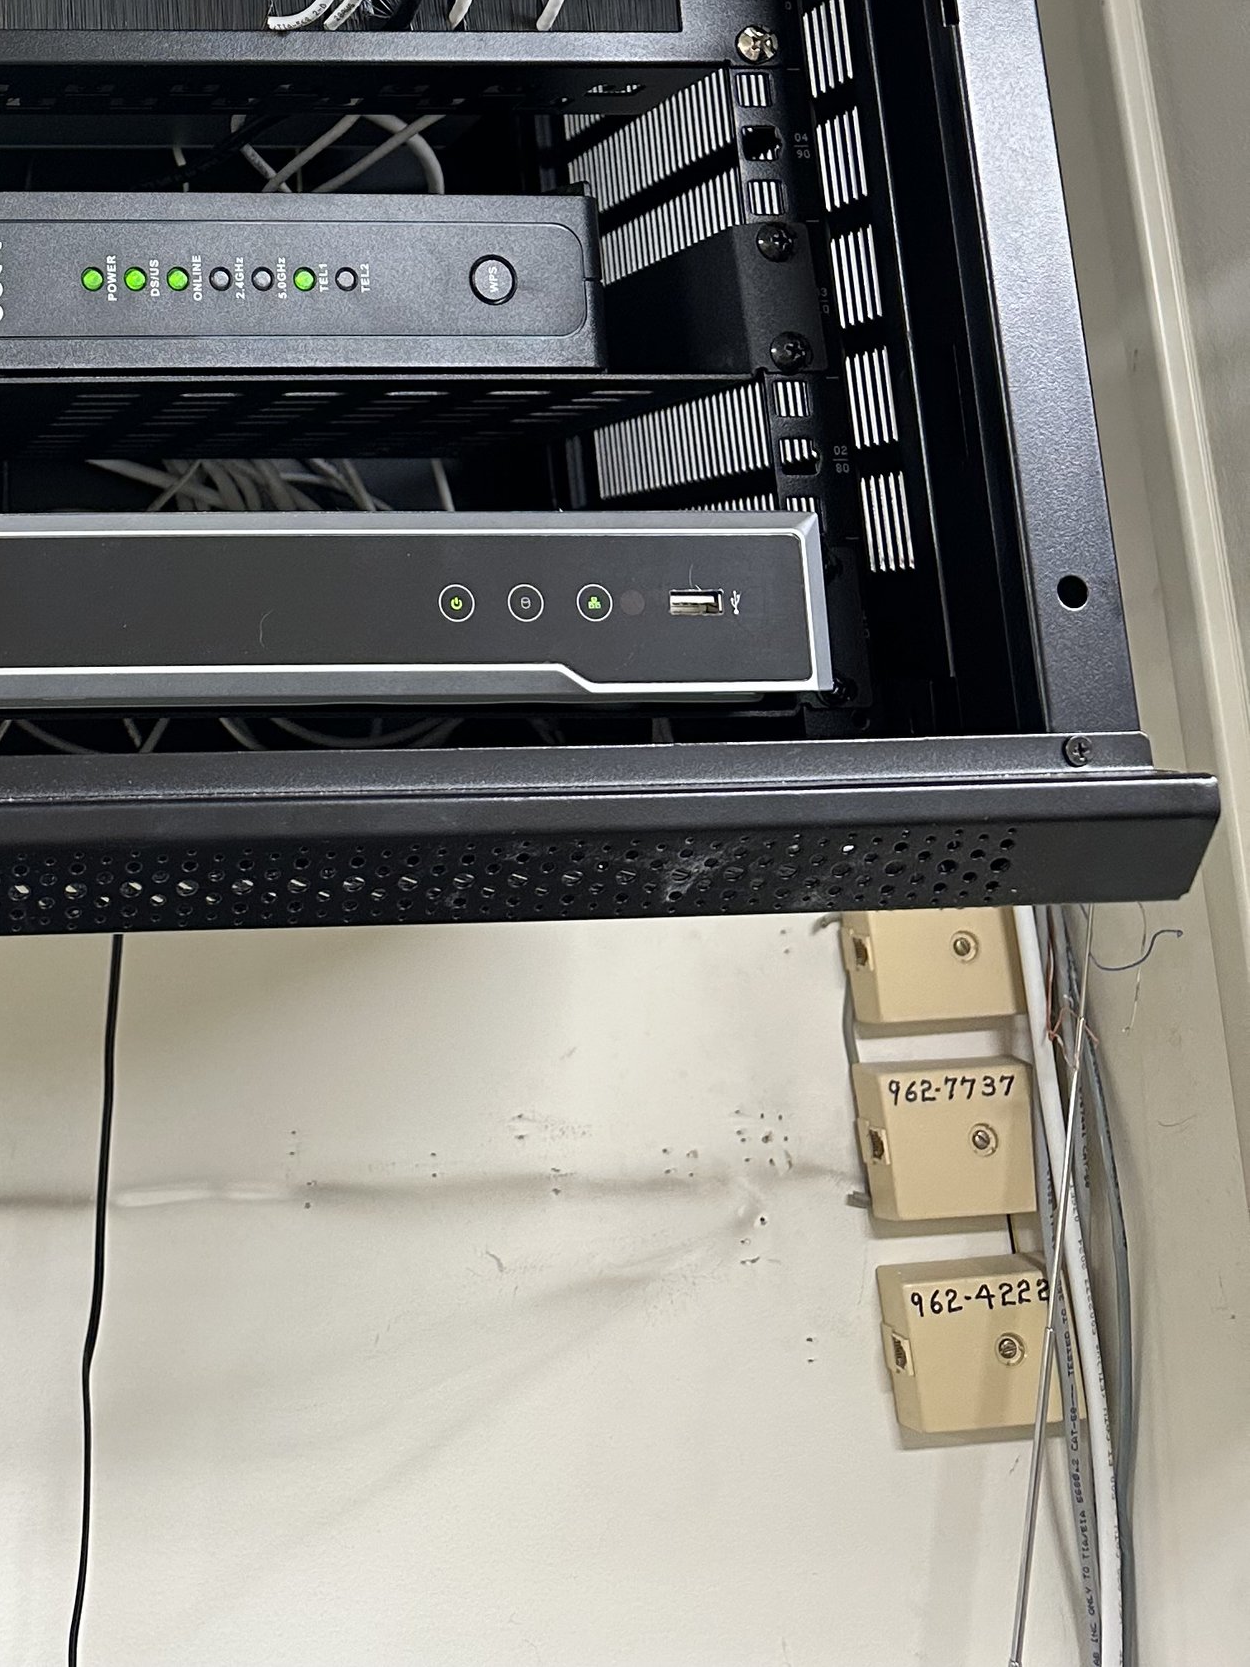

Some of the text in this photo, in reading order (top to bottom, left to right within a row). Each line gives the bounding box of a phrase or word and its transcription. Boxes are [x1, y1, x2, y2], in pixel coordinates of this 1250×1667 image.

[794, 132, 809, 143] 04
[106, 255, 118, 302] POWER
[150, 259, 160, 297] DS/US
[192, 255, 202, 301] ONLINE
[236, 257, 245, 300] 2.4GHz
[278, 257, 288, 300] 5.0GHz
[319, 263, 329, 293] TEL1
[360, 263, 370, 293] TEL2
[488, 266, 499, 293] WPS
[833, 445, 848, 456] 02
[888, 1075, 1016, 1106] 962-7737
[910, 1277, 1051, 1318] 962-4222
[1063, 1330, 1075, 1378] TESTED
